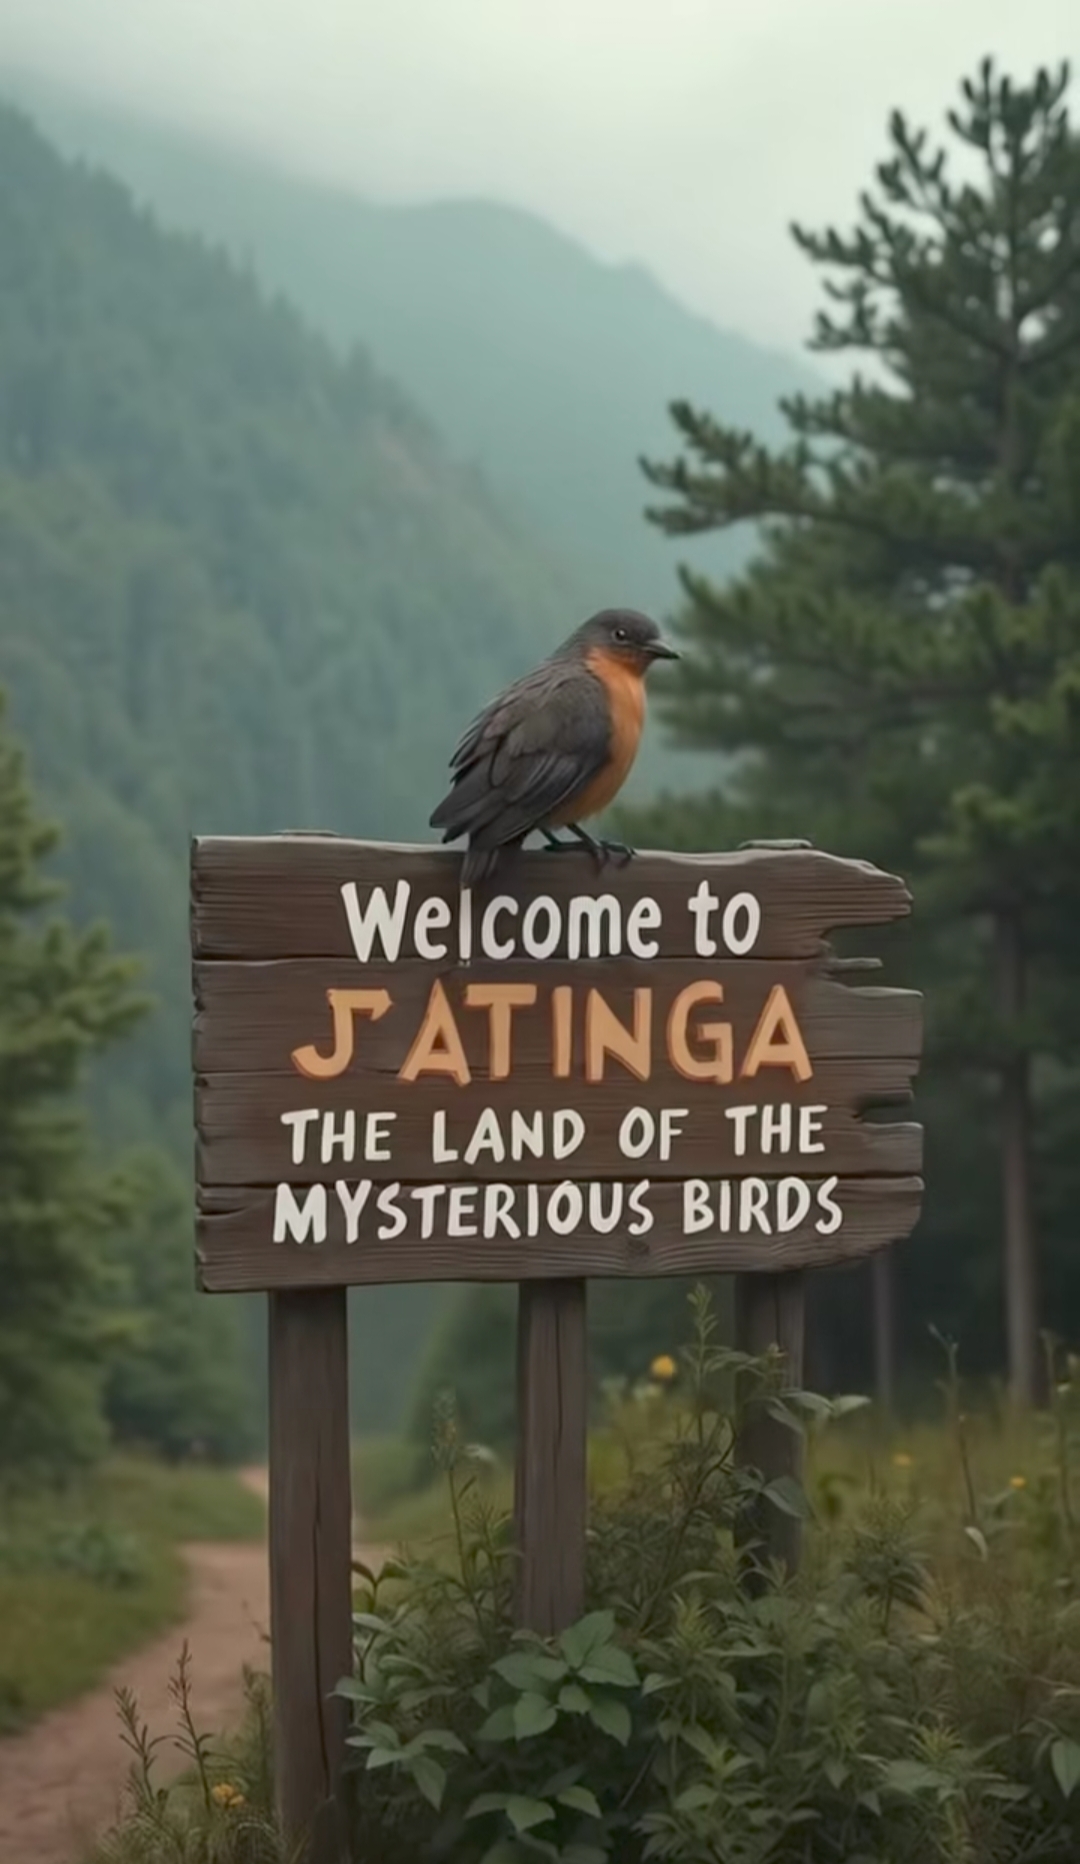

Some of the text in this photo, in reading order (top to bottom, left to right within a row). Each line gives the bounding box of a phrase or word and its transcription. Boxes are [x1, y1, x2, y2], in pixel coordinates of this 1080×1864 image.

[340, 879, 761, 964] Welcome to
[291, 979, 814, 1085] JATINGA
[280, 1103, 828, 1165] THE LAND OF THE
[273, 1176, 842, 1244] MYSTERIOUS BIRDS
